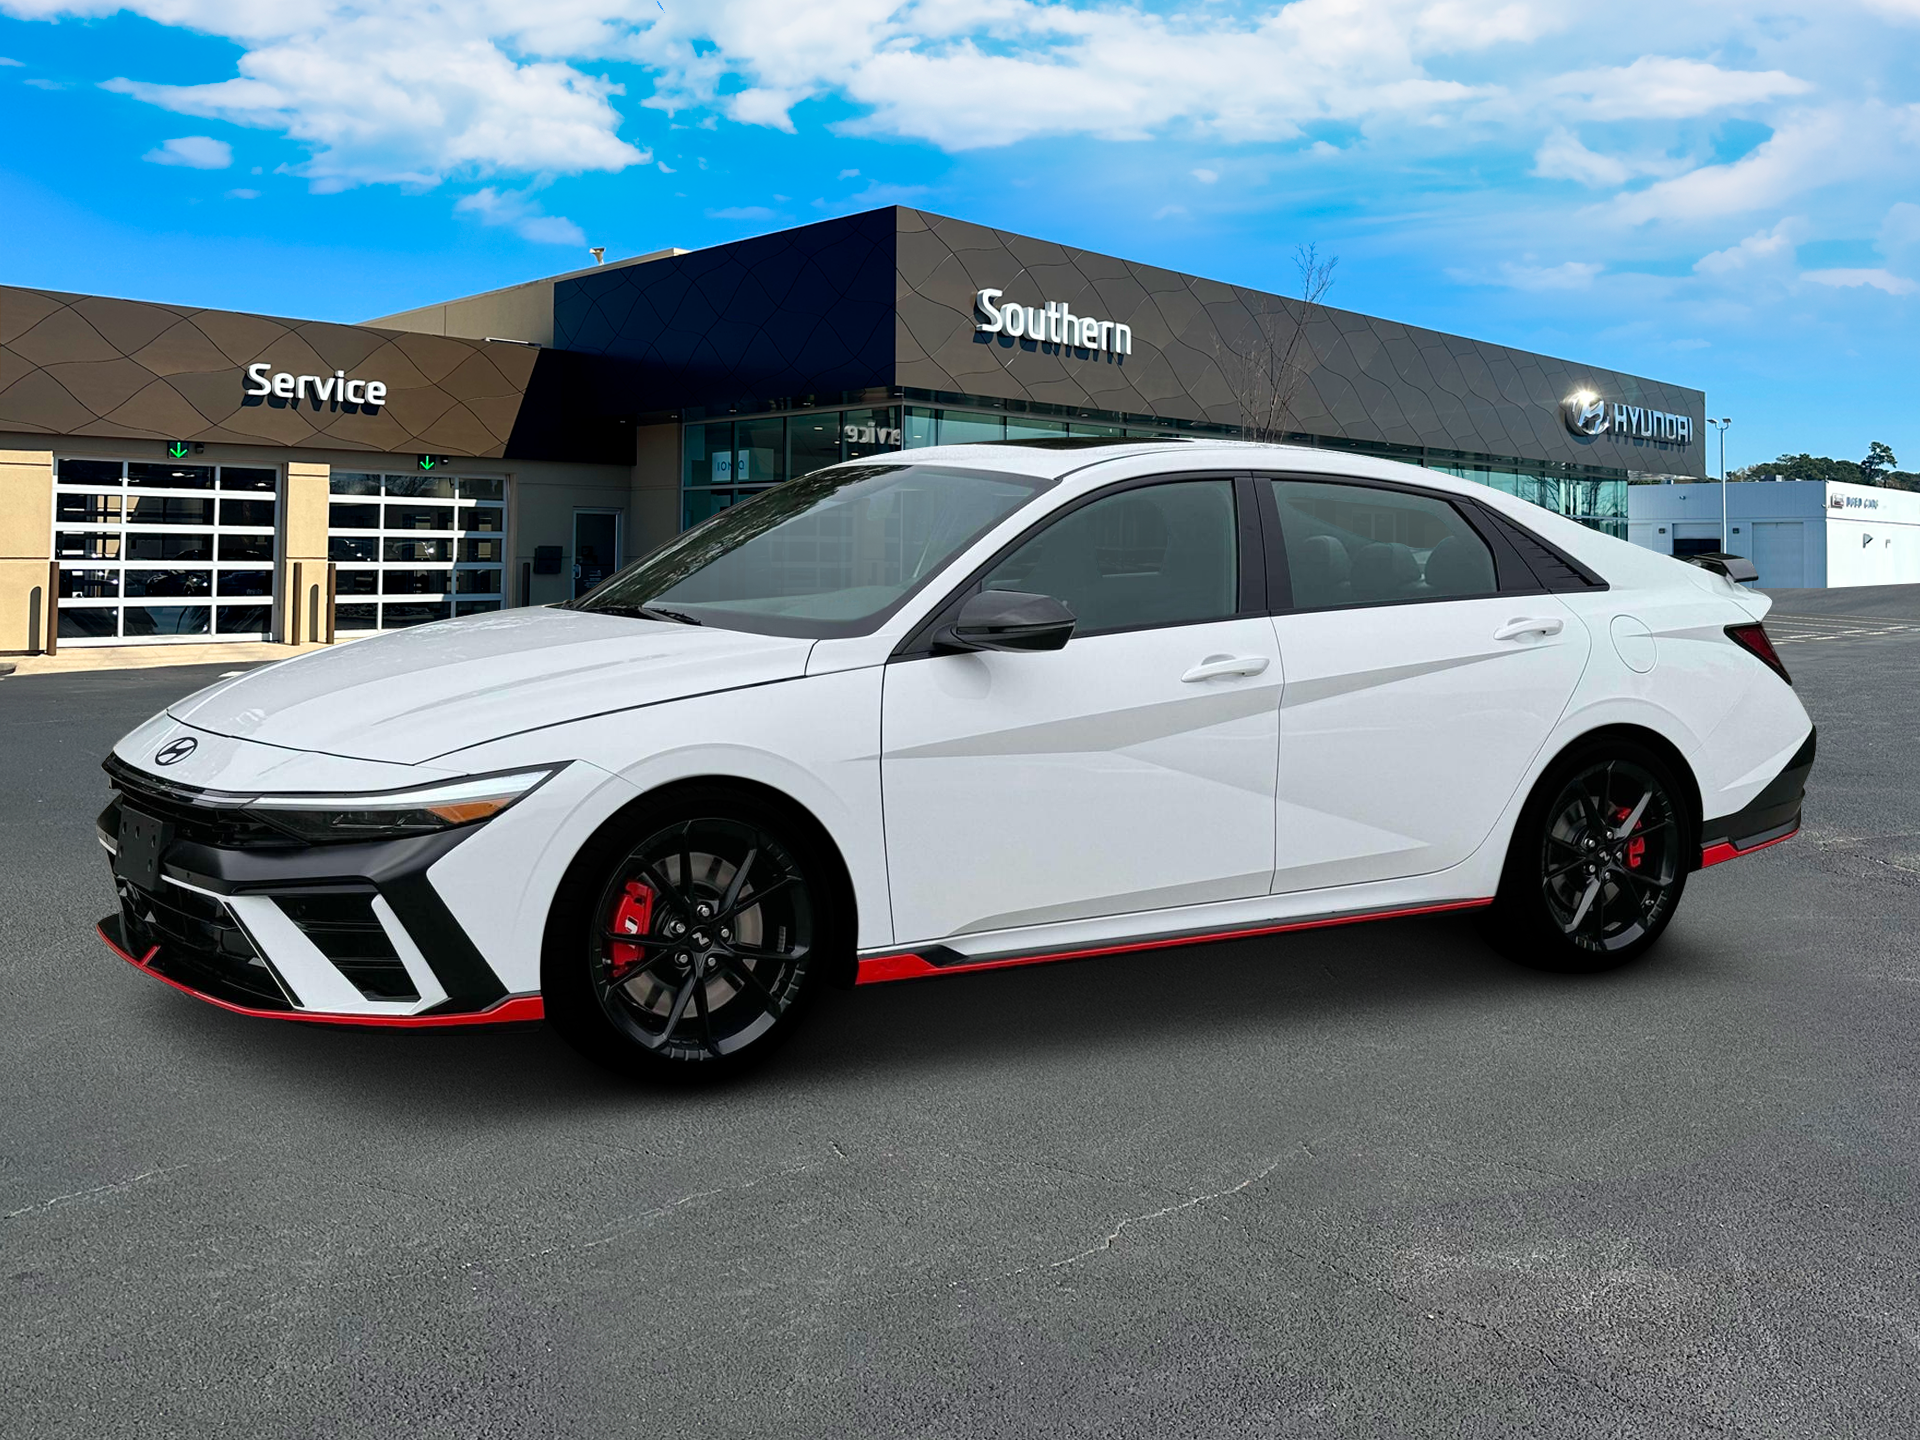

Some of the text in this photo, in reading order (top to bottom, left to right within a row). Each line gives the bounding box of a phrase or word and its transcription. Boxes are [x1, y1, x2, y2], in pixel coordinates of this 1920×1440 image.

[976, 288, 1132, 355] Southern
[246, 363, 387, 405] Service
[1613, 402, 1693, 443] HYUNDAI
